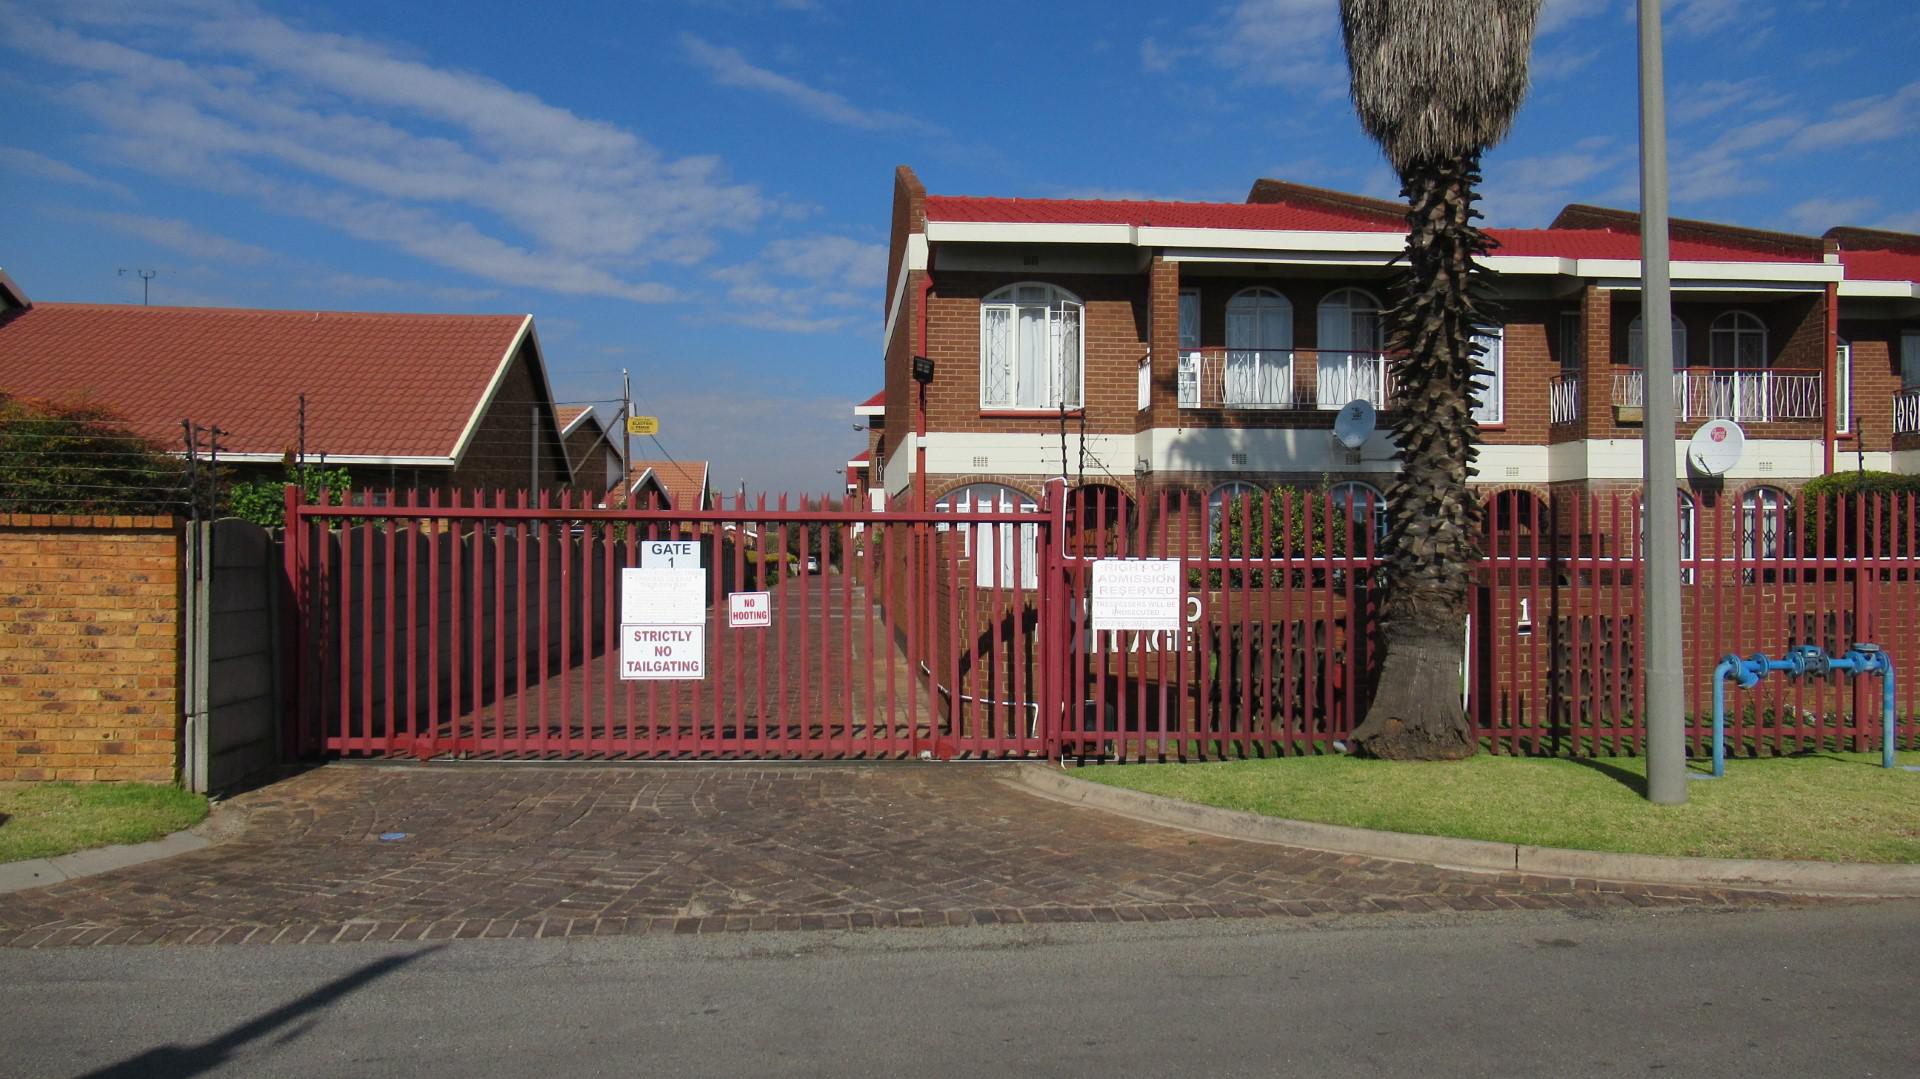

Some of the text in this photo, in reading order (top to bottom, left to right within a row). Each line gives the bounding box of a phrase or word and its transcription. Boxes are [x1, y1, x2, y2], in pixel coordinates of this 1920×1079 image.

[651, 543, 691, 555] GATE
[668, 557, 674, 568] 1
[1098, 574, 1176, 583] ADMISSION
[1099, 586, 1175, 595] RESERVED
[744, 599, 755, 607] NO
[733, 610, 767, 620] HOOTING
[634, 630, 692, 642] STRICTLY
[654, 646, 672, 657] NO
[626, 661, 699, 672] TAILGATING
